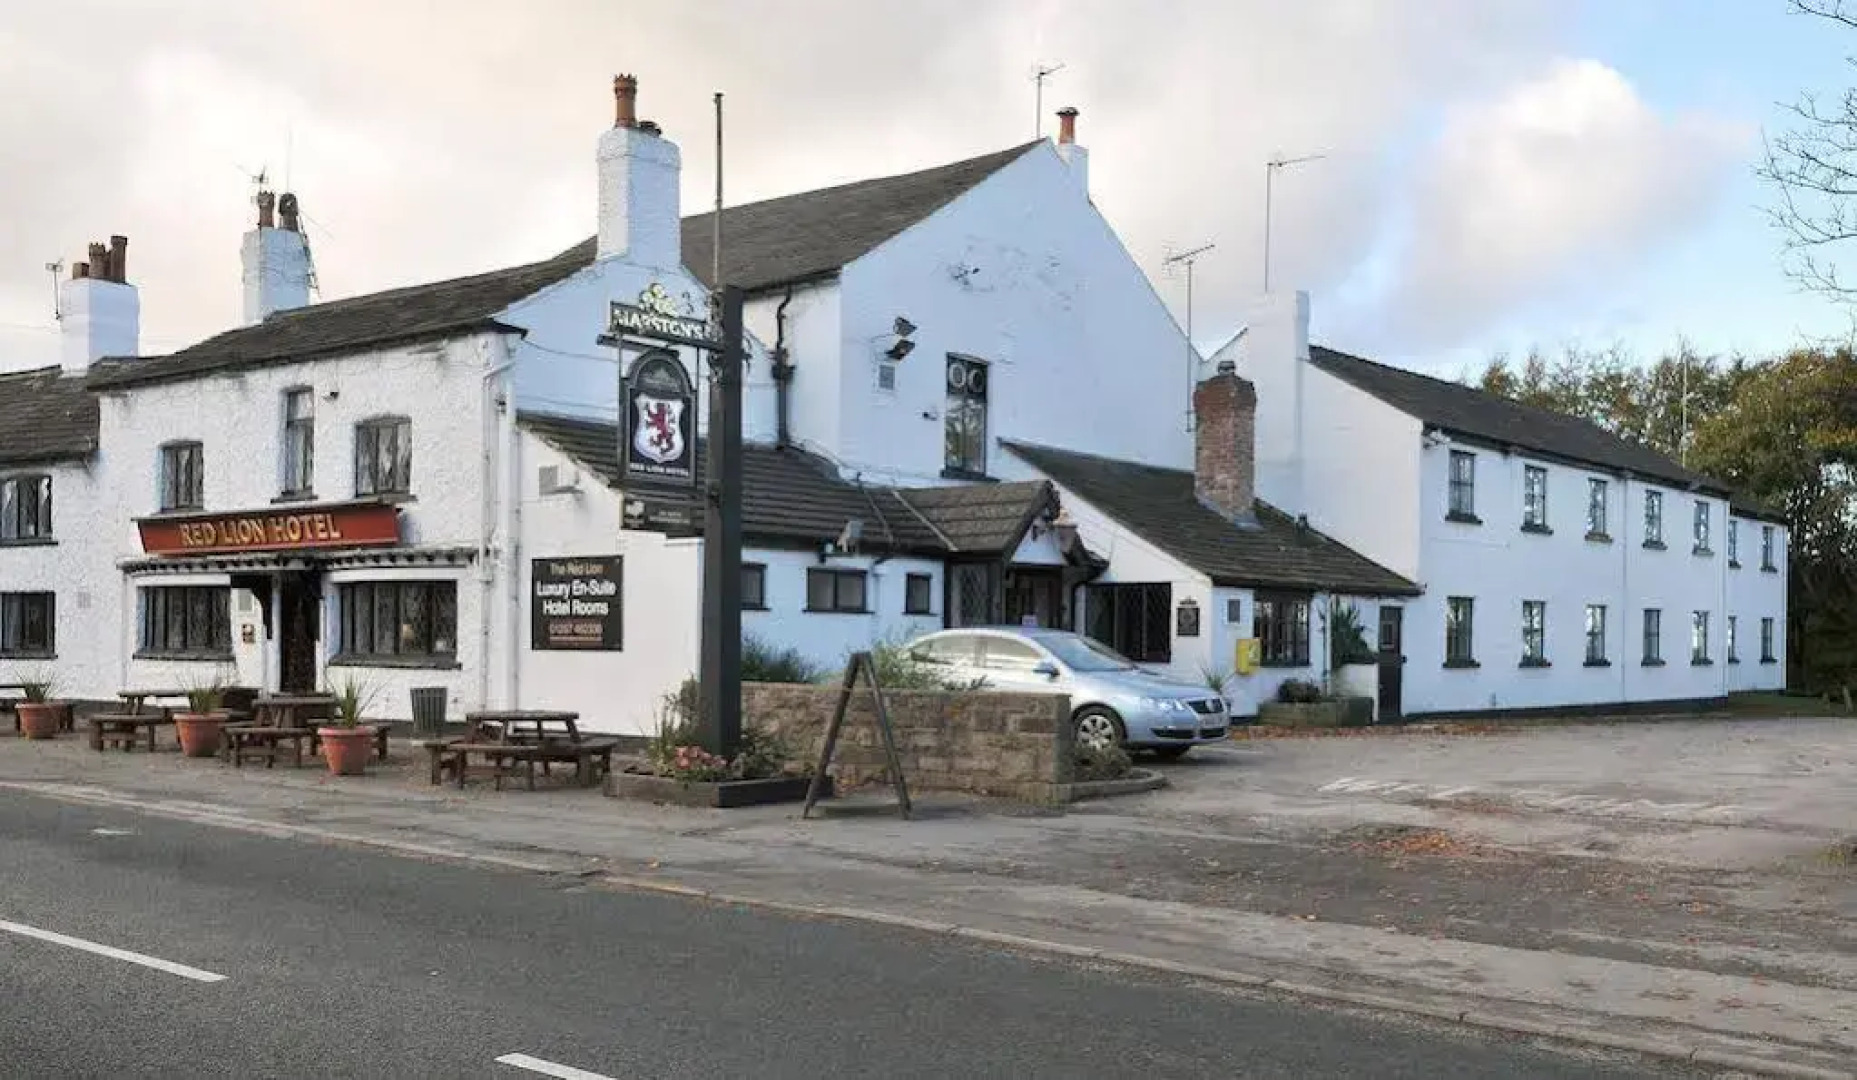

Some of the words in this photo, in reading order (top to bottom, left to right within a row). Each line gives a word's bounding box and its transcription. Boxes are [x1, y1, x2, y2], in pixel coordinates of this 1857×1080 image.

[179, 522, 217, 547] RED
[219, 517, 267, 544] LION
[270, 512, 343, 542] HOTEL
[551, 562, 566, 575] The
[567, 561, 584, 576] Red
[586, 562, 603, 575] Lion
[537, 580, 570, 599] Luxury
[572, 579, 616, 596] En-Suite
[543, 599, 571, 615] Hotel
[572, 599, 609, 615] Rooms
